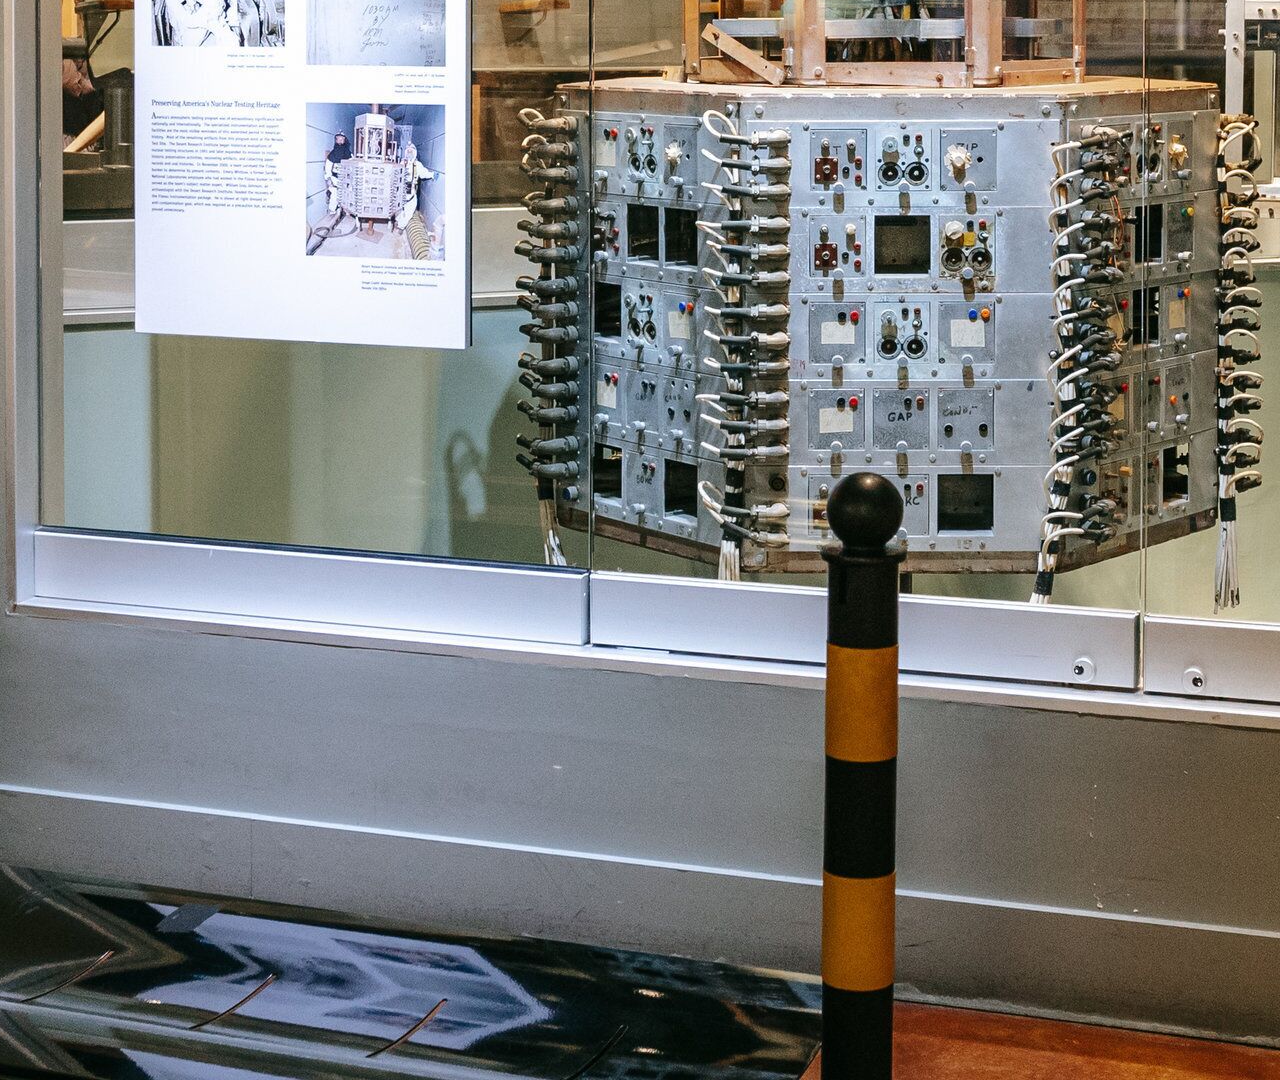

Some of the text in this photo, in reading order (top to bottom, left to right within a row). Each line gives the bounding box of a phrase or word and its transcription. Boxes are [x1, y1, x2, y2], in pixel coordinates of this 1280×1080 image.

[151, 99, 181, 108] Preserving
[211, 100, 233, 108] Nuclear
[234, 101, 255, 109] Testing
[256, 101, 281, 109] Heritage
[887, 411, 913, 423] GAP
